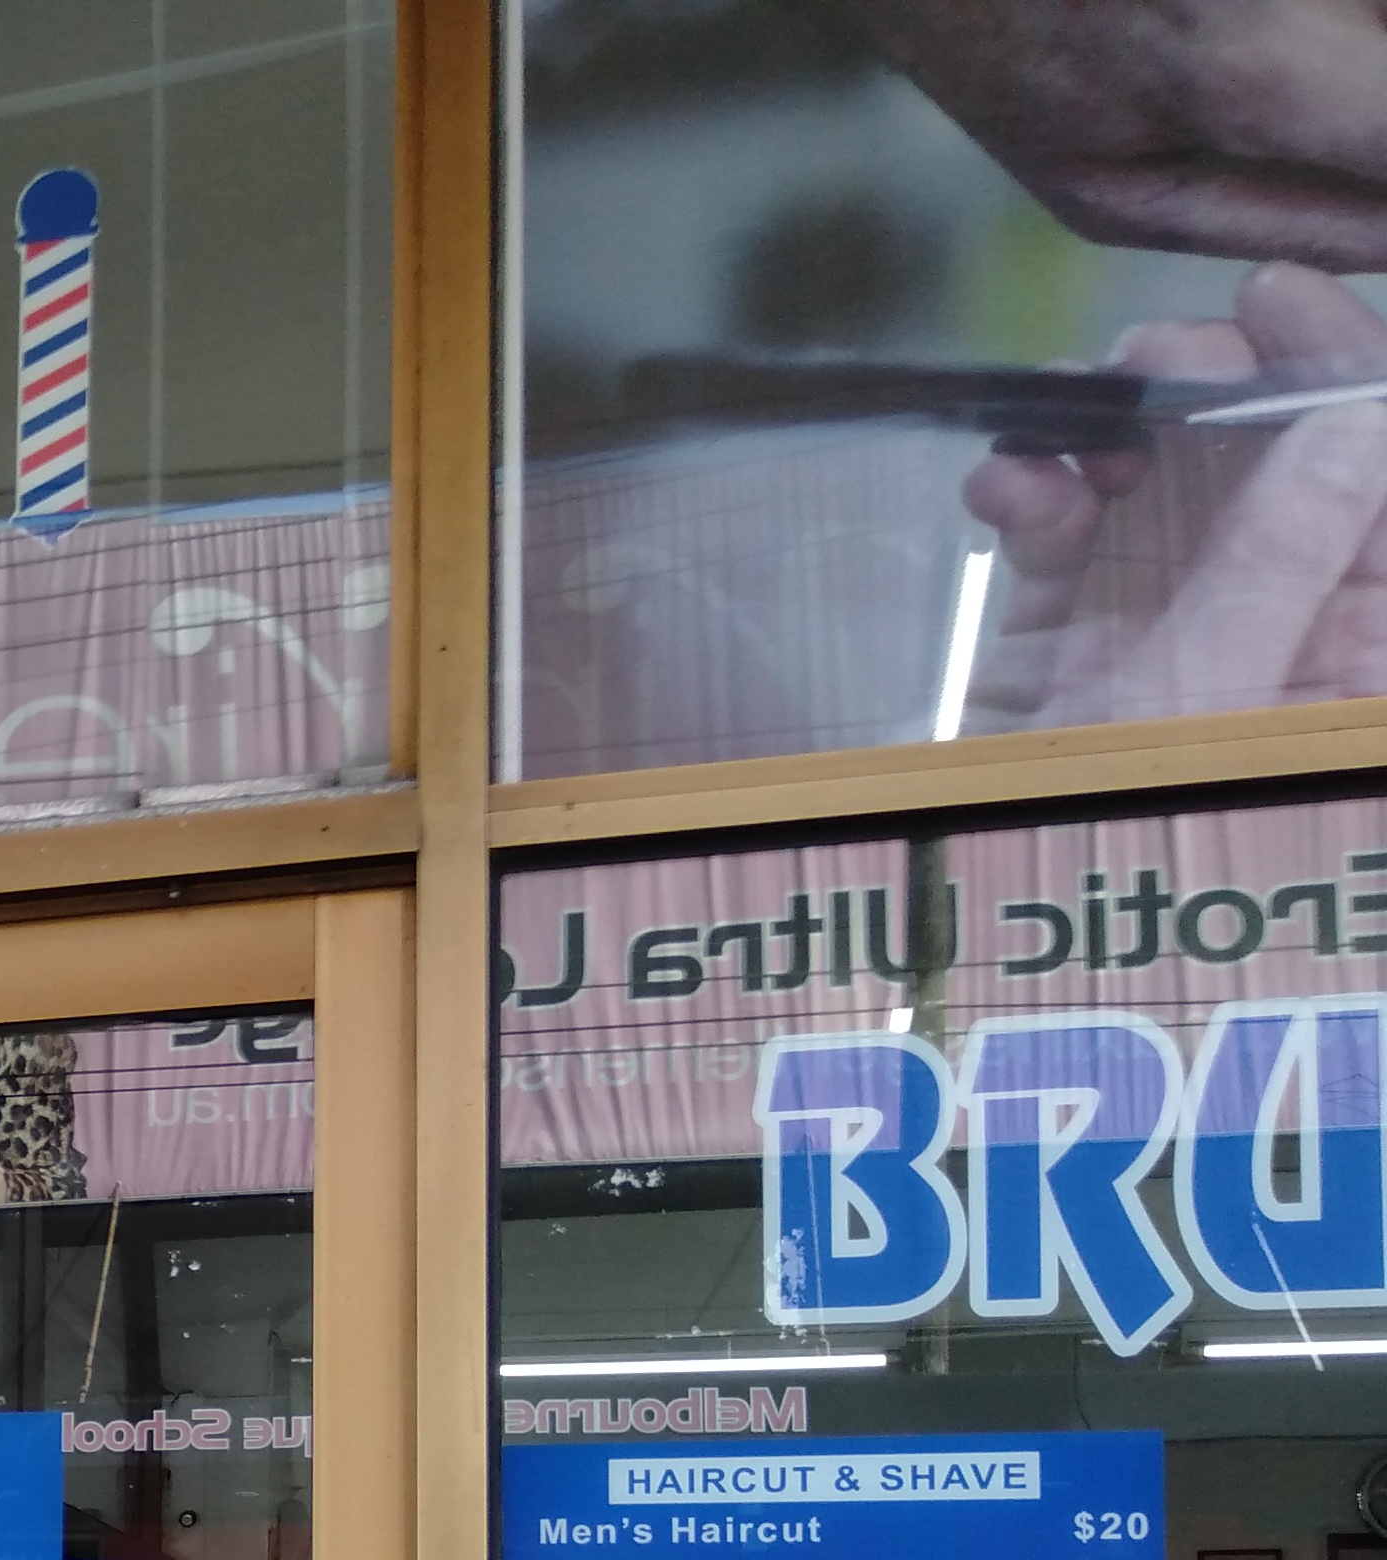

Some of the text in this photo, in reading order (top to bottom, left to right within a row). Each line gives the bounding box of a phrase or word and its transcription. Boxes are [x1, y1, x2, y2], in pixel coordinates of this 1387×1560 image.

[626, 1462, 1029, 1496] HAIRCUT & SHAVE
[538, 1510, 1150, 1545] Men's Haircut $20
